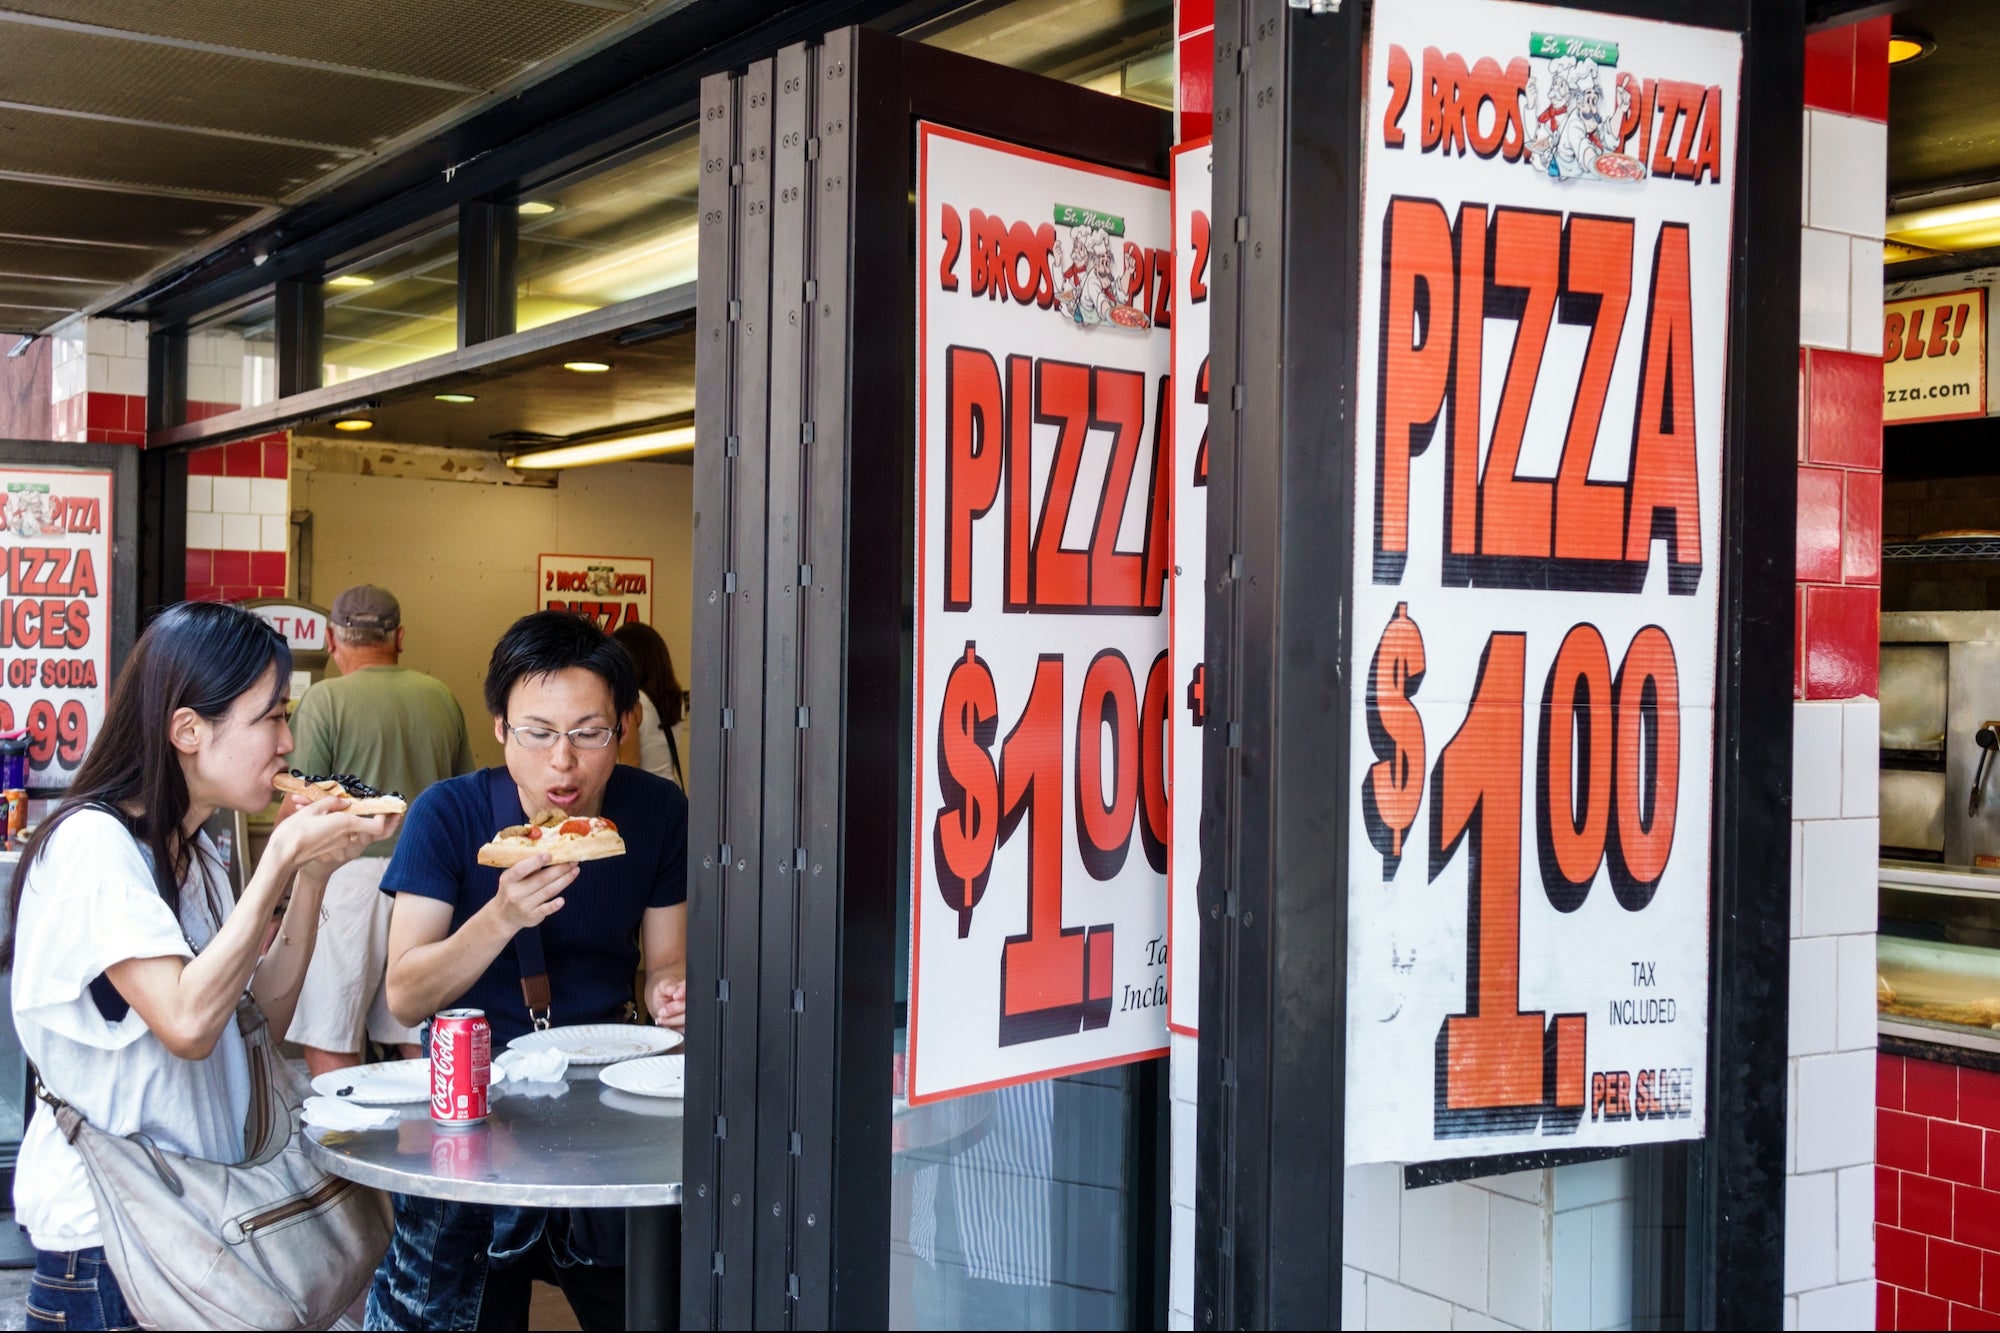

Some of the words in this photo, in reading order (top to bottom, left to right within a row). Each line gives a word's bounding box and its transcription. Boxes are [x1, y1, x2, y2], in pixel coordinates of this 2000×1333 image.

[1566, 39, 1606, 59] Marks
[1384, 44, 1412, 149] 2
[1616, 72, 1721, 185] PIZZA
[1083, 212, 1115, 230] Marks
[940, 203, 962, 293] 2
[1123, 241, 1171, 329] PIZ
[1372, 195, 1703, 596] PIZZA
[546, 570, 554, 592] 2
[8, 658, 37, 688] OF
[41, 658, 97, 688] SODA
[1362, 601, 1681, 1140] $1.00
[1145, 934, 1167, 966] Ta
[1632, 962, 1656, 987] TAX
[1120, 975, 1167, 1012] Inclu
[1610, 999, 1676, 1025] INCLUDED
[1592, 1070, 1631, 1123] PER
